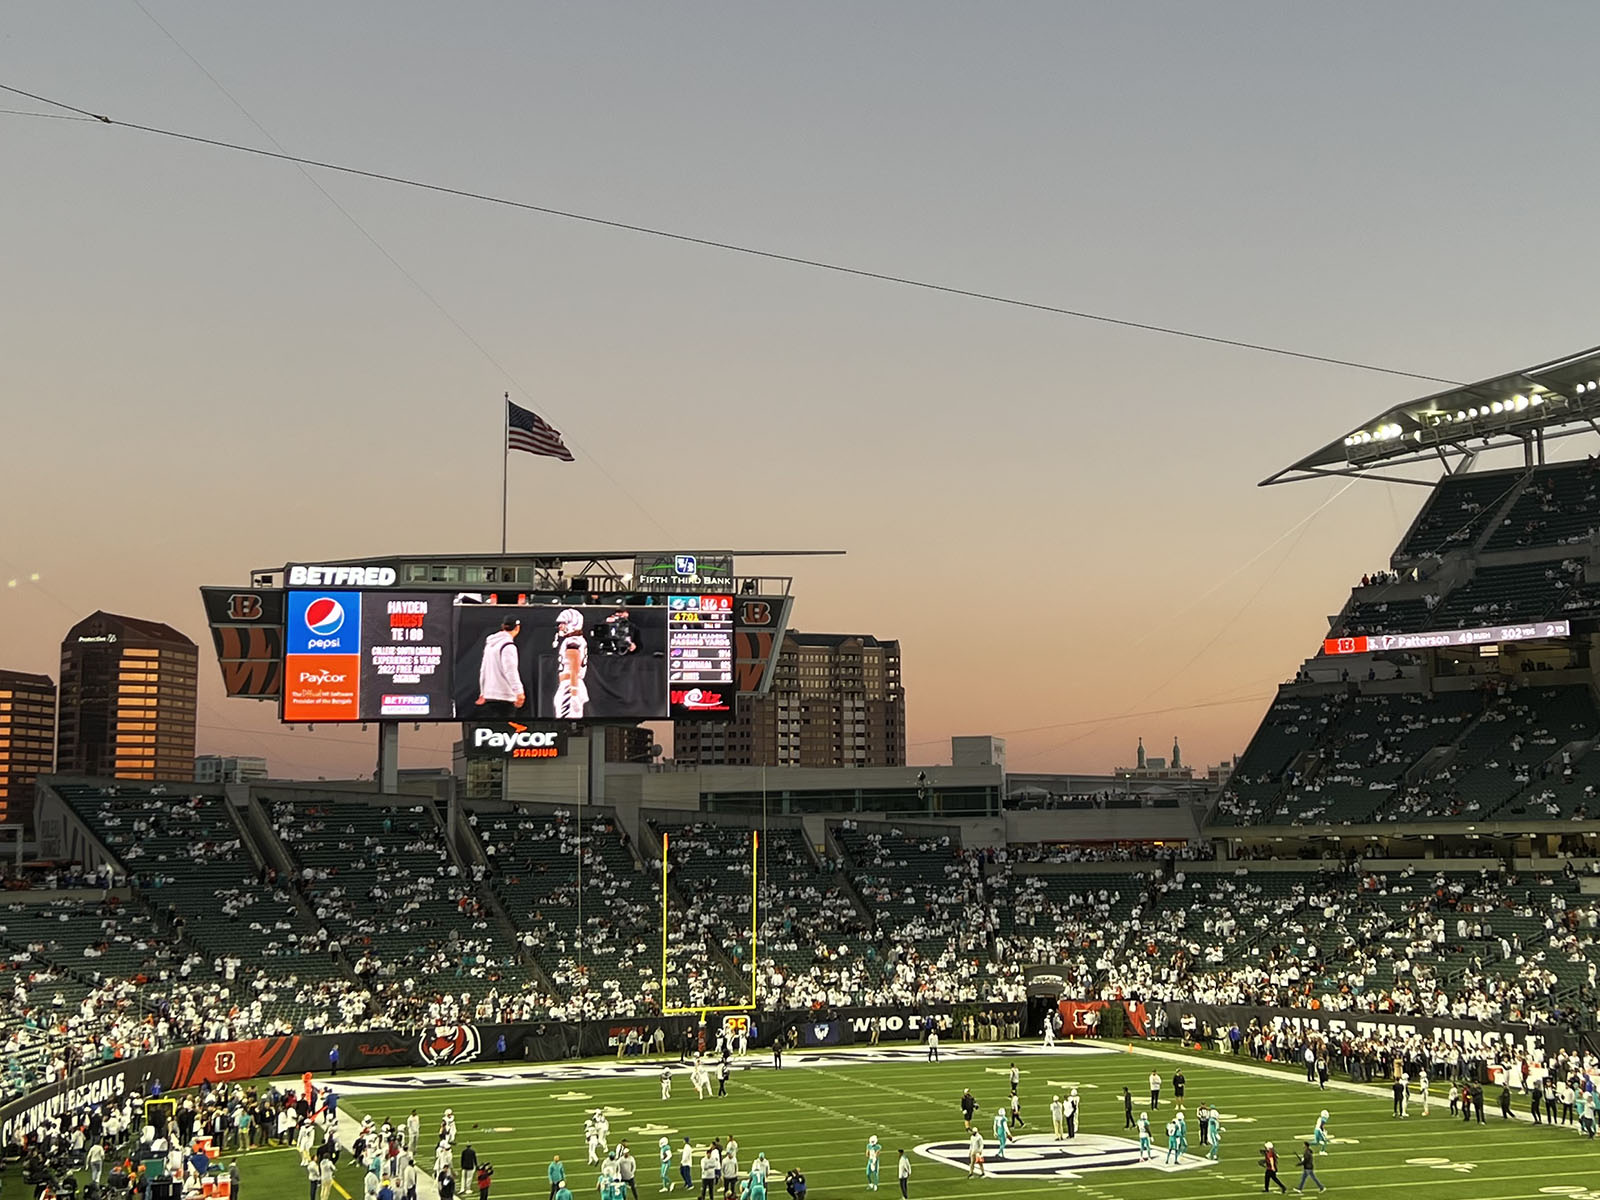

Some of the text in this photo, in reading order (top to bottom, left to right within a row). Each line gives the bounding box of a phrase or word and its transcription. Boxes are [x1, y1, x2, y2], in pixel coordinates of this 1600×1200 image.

[289, 566, 397, 586] BETFRED
[639, 575, 731, 586] FIFTH THIRD BANK
[387, 601, 428, 614] HAYDEN
[391, 628, 404, 641] TE
[1398, 635, 1449, 648] Patterson
[1459, 633, 1473, 644] 49
[1501, 628, 1522, 640] 302
[1546, 625, 1555, 636] 2
[308, 638, 341, 650] pepsi
[299, 670, 347, 685] Paycor
[384, 696, 428, 705] BETFRED
[475, 728, 558, 752] Paycor
[513, 748, 558, 758] STADIUM
